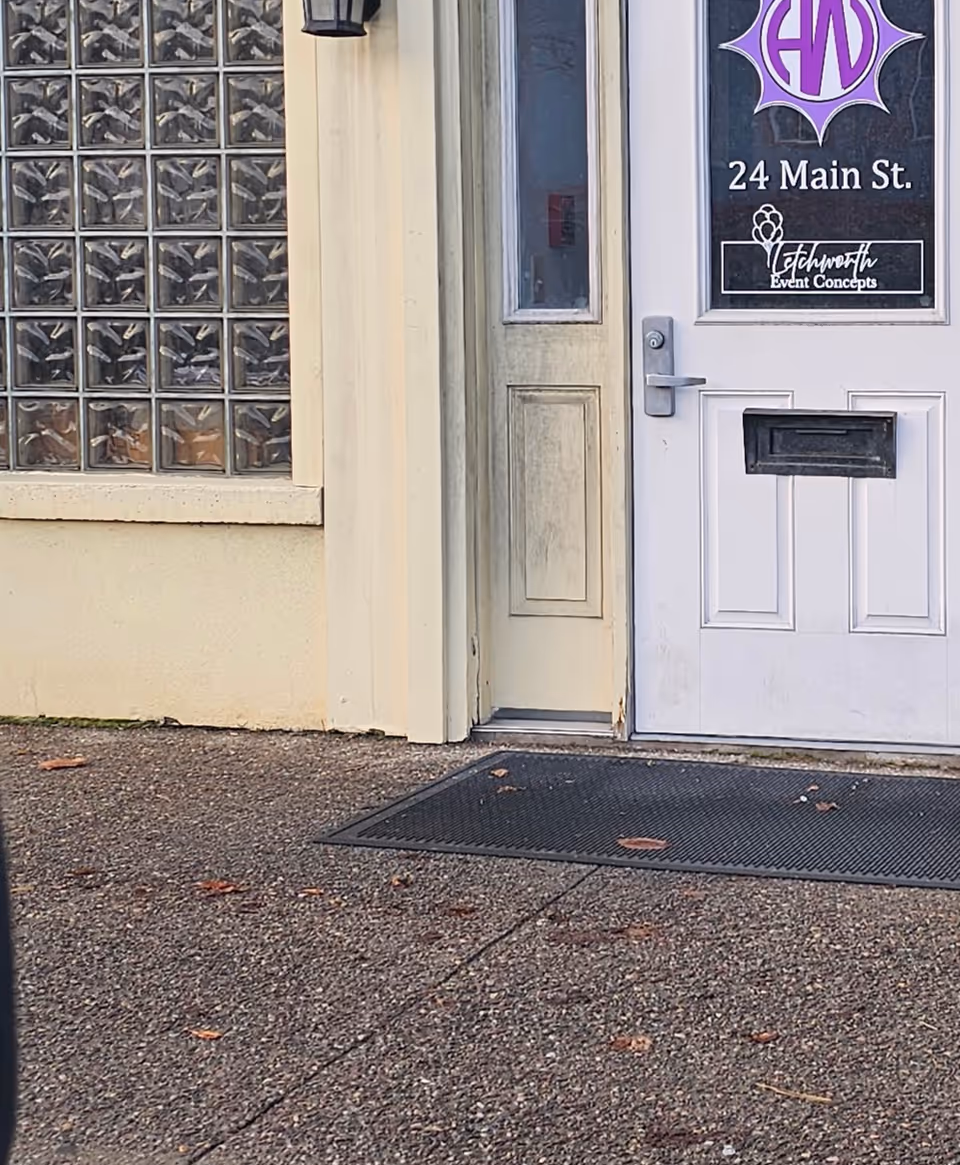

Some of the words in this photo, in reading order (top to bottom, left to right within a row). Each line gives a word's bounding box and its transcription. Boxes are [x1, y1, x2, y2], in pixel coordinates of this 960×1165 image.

[728, 160, 770, 190] 24
[780, 160, 862, 190] Main
[871, 159, 912, 190] St.
[772, 242, 878, 283] Letchworth
[770, 275, 809, 289] Event
[813, 274, 877, 291] Concepts
